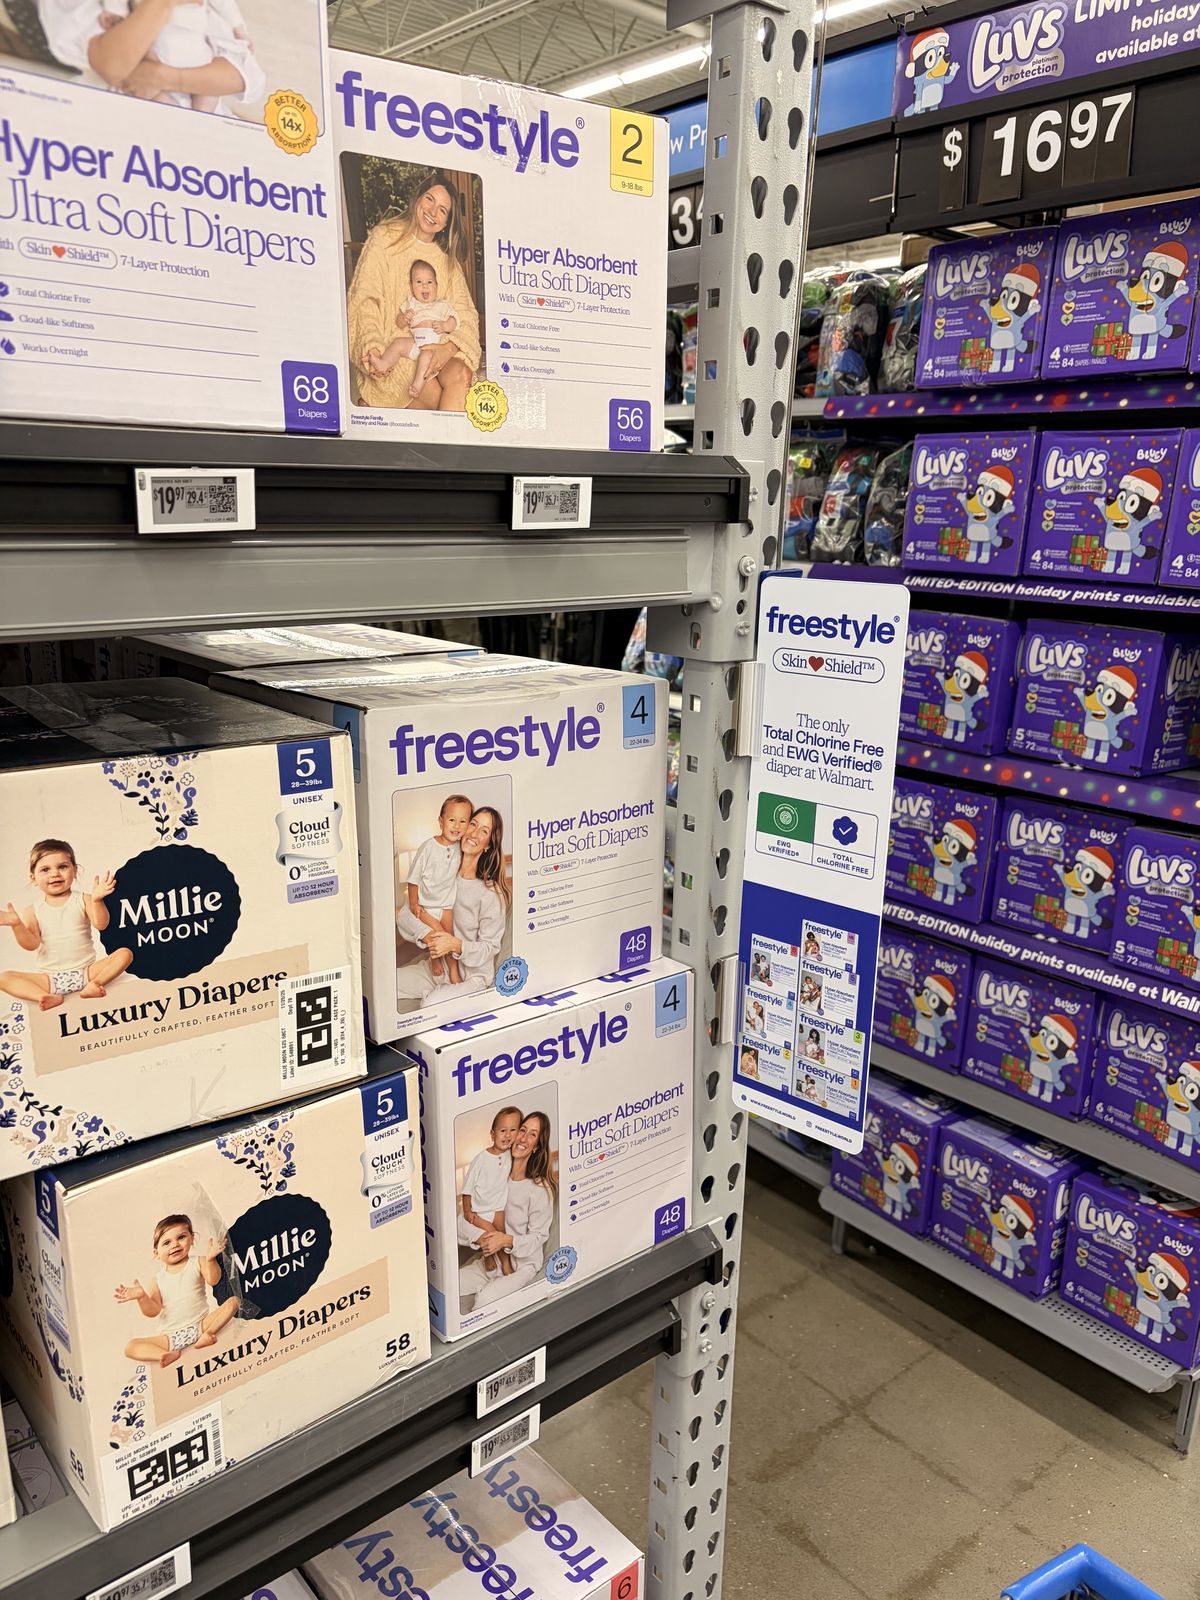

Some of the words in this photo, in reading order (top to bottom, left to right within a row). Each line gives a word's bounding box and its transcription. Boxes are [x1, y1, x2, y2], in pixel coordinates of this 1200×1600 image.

[1095, 31, 1179, 64] available
[1002, 61, 1059, 85] protection
[274, 95, 307, 112] BETTER
[281, 116, 302, 133] 14x
[621, 122, 643, 166] 2
[122, 144, 328, 219] Absorbent
[96, 193, 178, 245] Soft
[181, 206, 316, 267] Diapers
[0, 237, 14, 251] ith
[119, 255, 159, 271] 7-Layer
[159, 260, 210, 278] Protection
[497, 238, 551, 267] Hyper
[552, 247, 638, 277] Absorbent
[16, 287, 38, 299] Total
[497, 263, 540, 289] Ultra
[541, 269, 574, 293] Soft
[575, 273, 632, 301] Diapers
[498, 292, 515, 303] With
[576, 301, 600, 313] 7-Layer
[599, 302, 631, 316] Protection
[18, 314, 61, 327] Cloud-like
[61, 318, 95, 331] Softness
[21, 342, 48, 354] Works
[49, 345, 89, 358] Overnight
[1049, 346, 1061, 361] 4
[292, 375, 330, 404] 68
[473, 384, 500, 397] BETTER
[297, 408, 328, 421] Diapers
[478, 402, 496, 414] 14x
[616, 406, 643, 431] 56
[618, 432, 642, 444] Diapers
[902, 575, 1016, 595] LIMITED-EDITION
[1014, 584, 1072, 601] holiday
[1071, 589, 1121, 603] prints
[1122, 594, 1200, 608] available
[630, 694, 649, 726] 4
[795, 712, 821, 731] The
[821, 719, 850, 737] only
[762, 724, 794, 743] Total
[794, 728, 852, 753] Chlorine
[852, 743, 885, 758] Free
[295, 747, 316, 778] 5
[761, 743, 785, 759] and
[785, 748, 820, 764] EWG
[765, 758, 803, 779] diaper
[803, 765, 817, 781] at
[817, 768, 875, 791] Walmart.
[292, 794, 324, 806] UNISEX
[288, 816, 330, 835] Cloud
[527, 815, 577, 841] Hyper
[577, 799, 655, 829] Absorbent
[291, 837, 330, 850] SOFTNESS
[528, 840, 566, 862] Ultra
[566, 831, 597, 854] Soft
[597, 824, 649, 847] Diapers
[776, 838, 792, 849] EWG
[816, 857, 851, 871] CHLORINE
[850, 866, 870, 876] FREE
[832, 852, 854, 864] TOTAL
[292, 886, 304, 894] UP
[310, 883, 317, 891] 12
[317, 880, 335, 889] HOUR
[293, 886, 334, 900] ABSORBENCY
[119, 884, 223, 929] Millie
[625, 933, 648, 953] 48
[882, 901, 970, 938] MITED-EDITION
[969, 930, 1021, 959] holiday
[1020, 948, 1065, 971] prints
[1065, 962, 1137, 993] available
[1138, 985, 1159, 1000] at
[626, 954, 645, 963] Diapers
[505, 973, 519, 983] 14x
[59, 996, 173, 1039] Luxury
[178, 970, 289, 1009] Diapers
[663, 983, 681, 1013] 4
[79, 1026, 150, 1052] BEAUTIFULLY
[205, 1007, 248, 1023] FEATHER
[251, 1000, 276, 1013] SOFT
[376, 1087, 394, 1117] 5
[568, 1112, 613, 1140] Hyper
[613, 1082, 685, 1122] Absorbent
[374, 1126, 401, 1142] UNISEX
[569, 1135, 603, 1160] Ultra
[604, 1123, 632, 1147] Soft
[632, 1105, 680, 1136] Diapers
[371, 1145, 406, 1169] Cloud
[373, 1164, 406, 1182] SOFTNESS
[40, 1180, 52, 1214] 5
[375, 1206, 409, 1224] ABSORBENCY
[659, 1205, 681, 1226] 48
[661, 1224, 679, 1236] Diapers
[229, 1224, 317, 1280] Millie
[554, 1261, 568, 1271] 14x
[175, 1329, 274, 1388] Luxury
[277, 1281, 372, 1336] Diapers
[385, 1333, 412, 1358] 58
[192, 1364, 254, 1397] BEAUTIFULLY
[300, 1326, 337, 1347] FEATHER
[338, 1311, 361, 1327] SOFT
[378, 1356, 398, 1370] LUXURY
[396, 1346, 418, 1361] DIAPERS
[617, 1575, 633, 1600] 6
